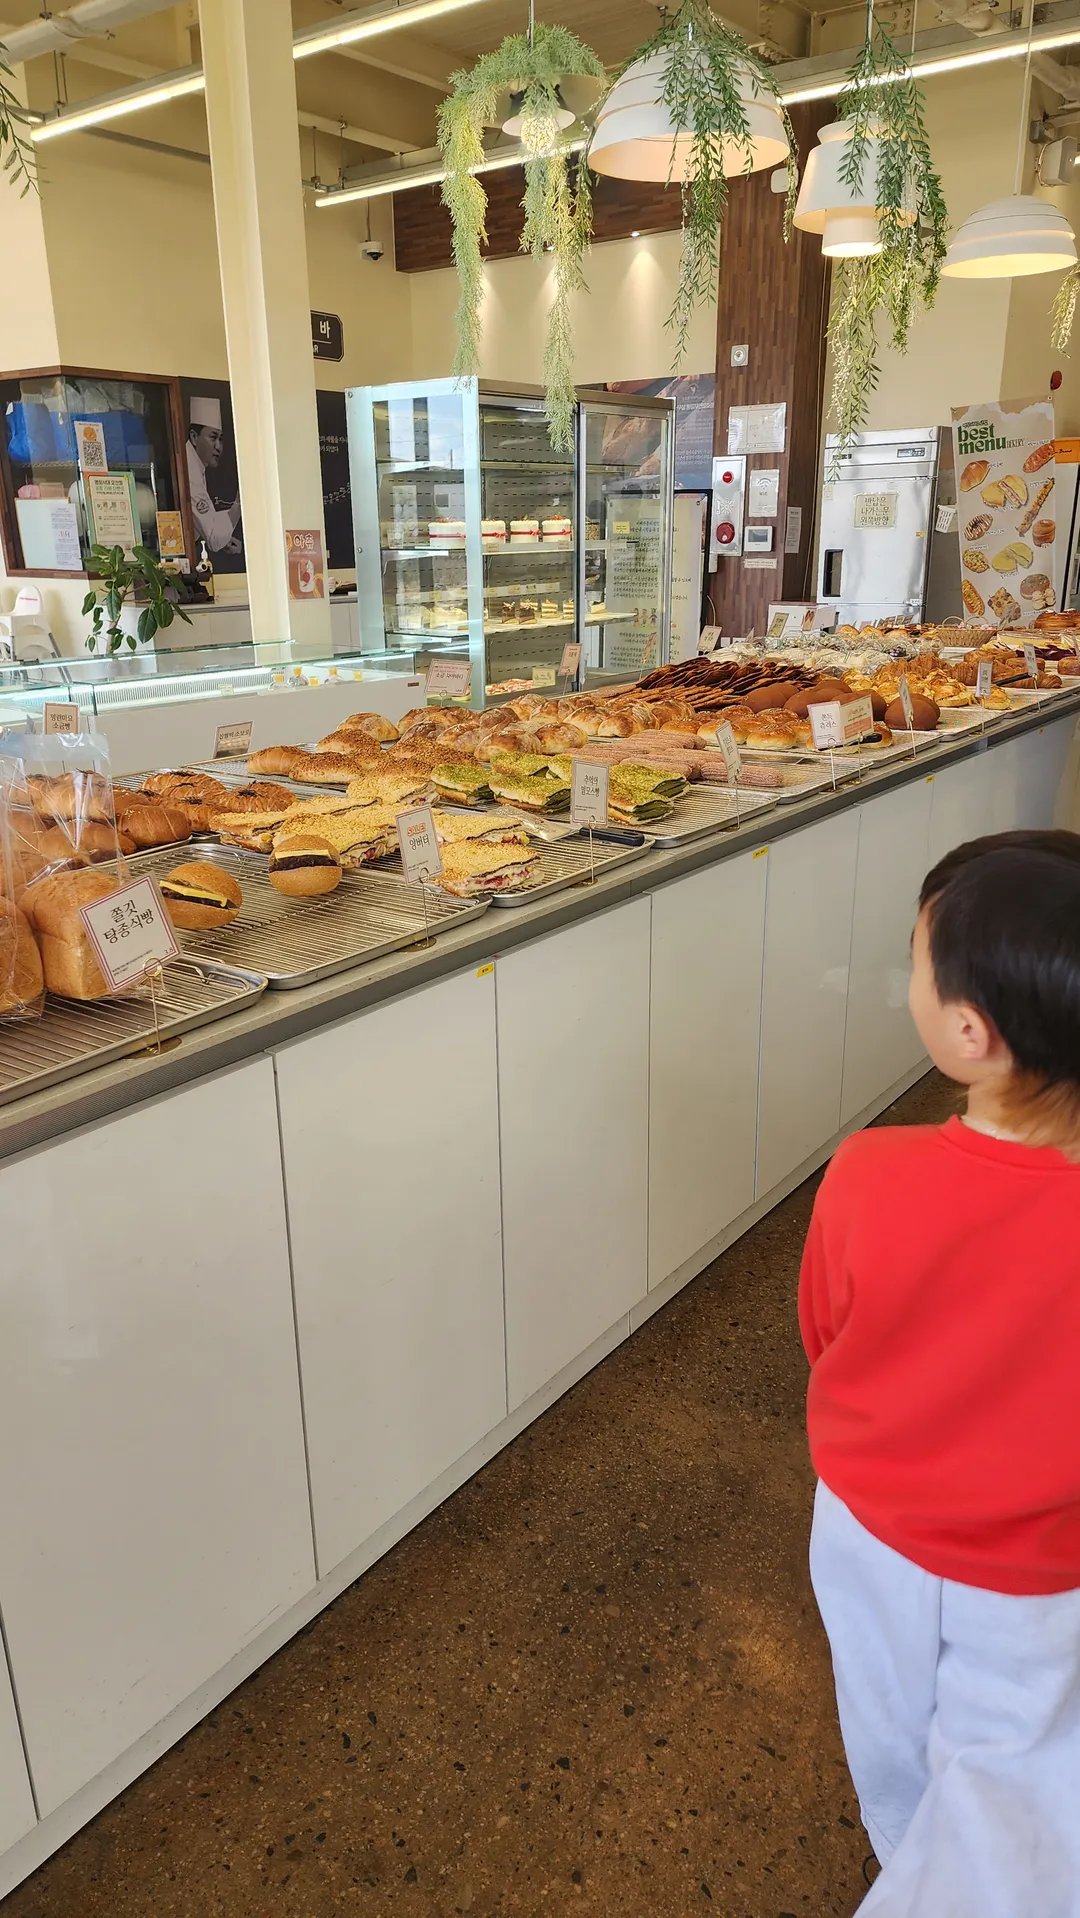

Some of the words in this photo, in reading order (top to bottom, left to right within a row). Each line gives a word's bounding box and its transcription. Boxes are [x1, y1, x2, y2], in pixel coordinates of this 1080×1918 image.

[319, 320, 331, 339] 바
[957, 423, 995, 442] best
[958, 437, 1007, 455] menu
[864, 496, 887, 507] 반납은
[50, 713, 73, 722] 명란마요
[53, 722, 71, 731] 소금빵
[584, 774, 599, 787] 추억의
[409, 833, 430, 851] 앙버터
[110, 899, 138, 923] 쫄깃
[103, 908, 155, 944] 탕종식빵
